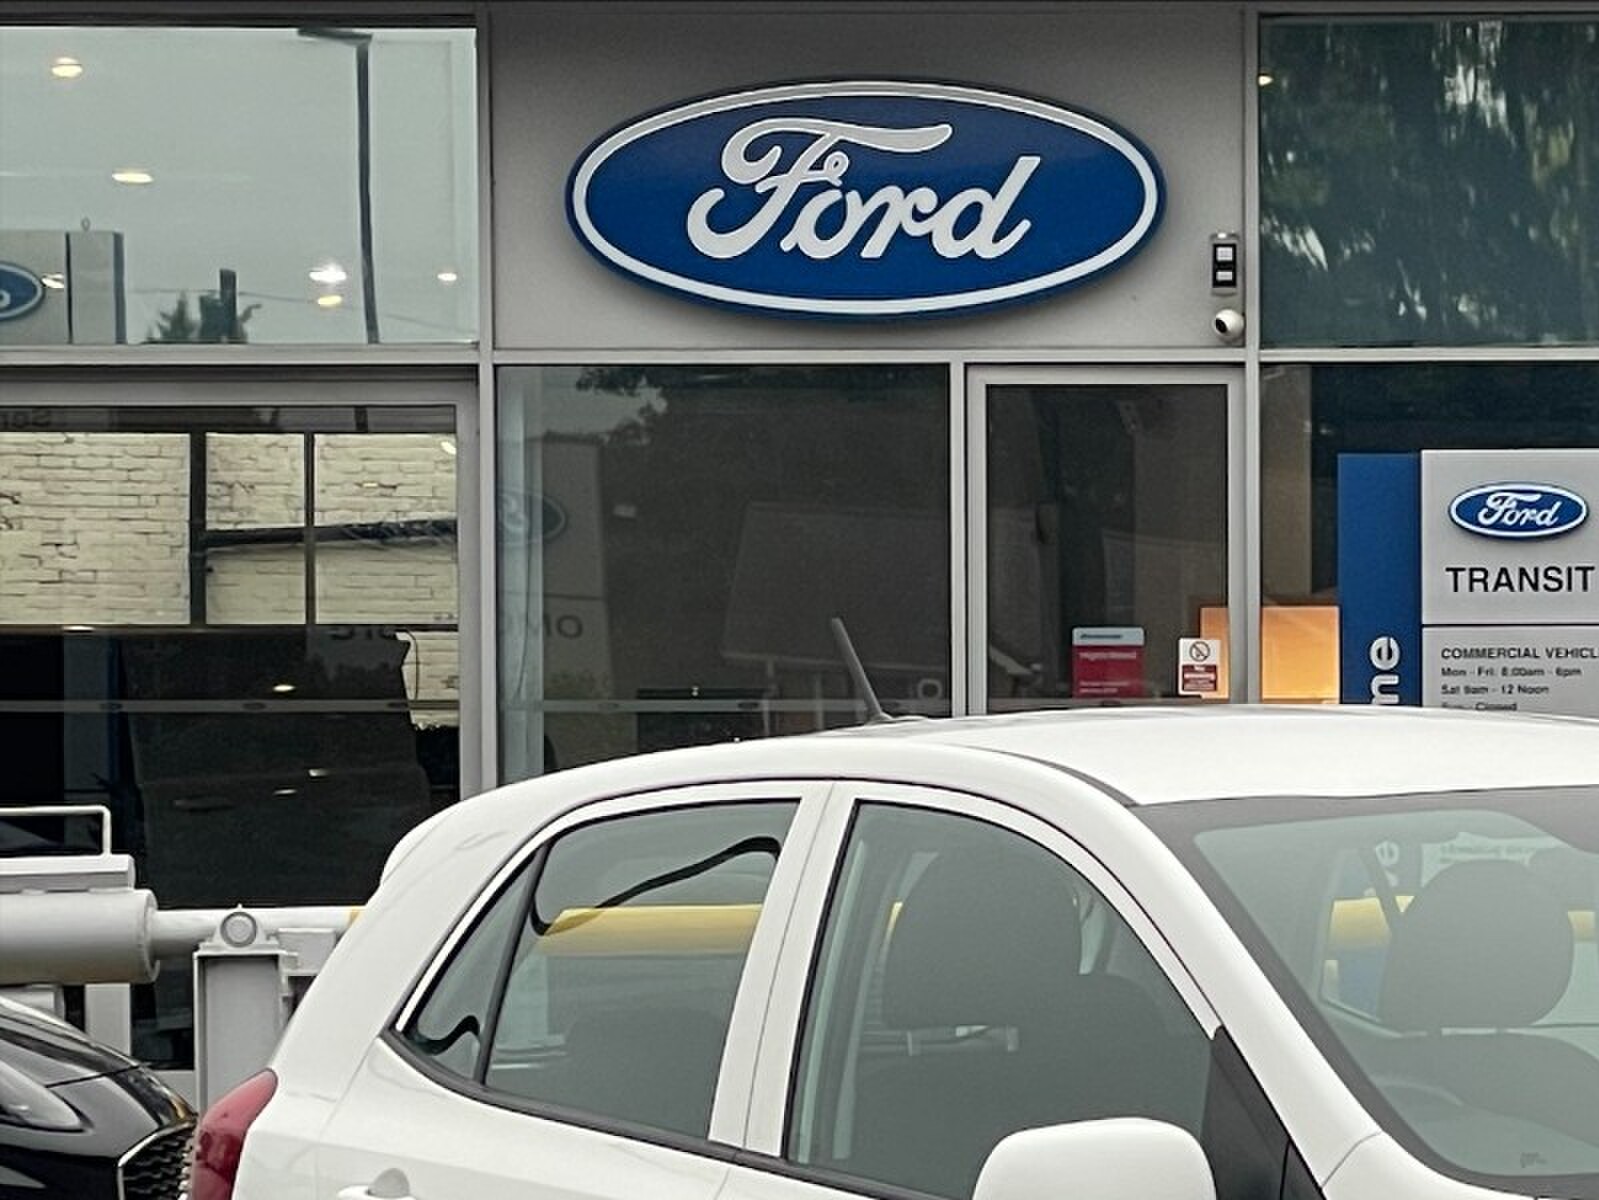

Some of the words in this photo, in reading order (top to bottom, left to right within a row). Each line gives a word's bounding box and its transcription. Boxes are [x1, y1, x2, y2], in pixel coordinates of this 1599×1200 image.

[686, 117, 1042, 260] Ford
[1477, 491, 1560, 528] Ford
[1445, 565, 1596, 593] TRANSIT
[1440, 647, 1541, 659] COMMERCIAL
[1440, 666, 1467, 677] Mon
[1440, 684, 1461, 695] Sat
[1500, 684, 1514, 695] 12
[1517, 684, 1550, 695] Noon
